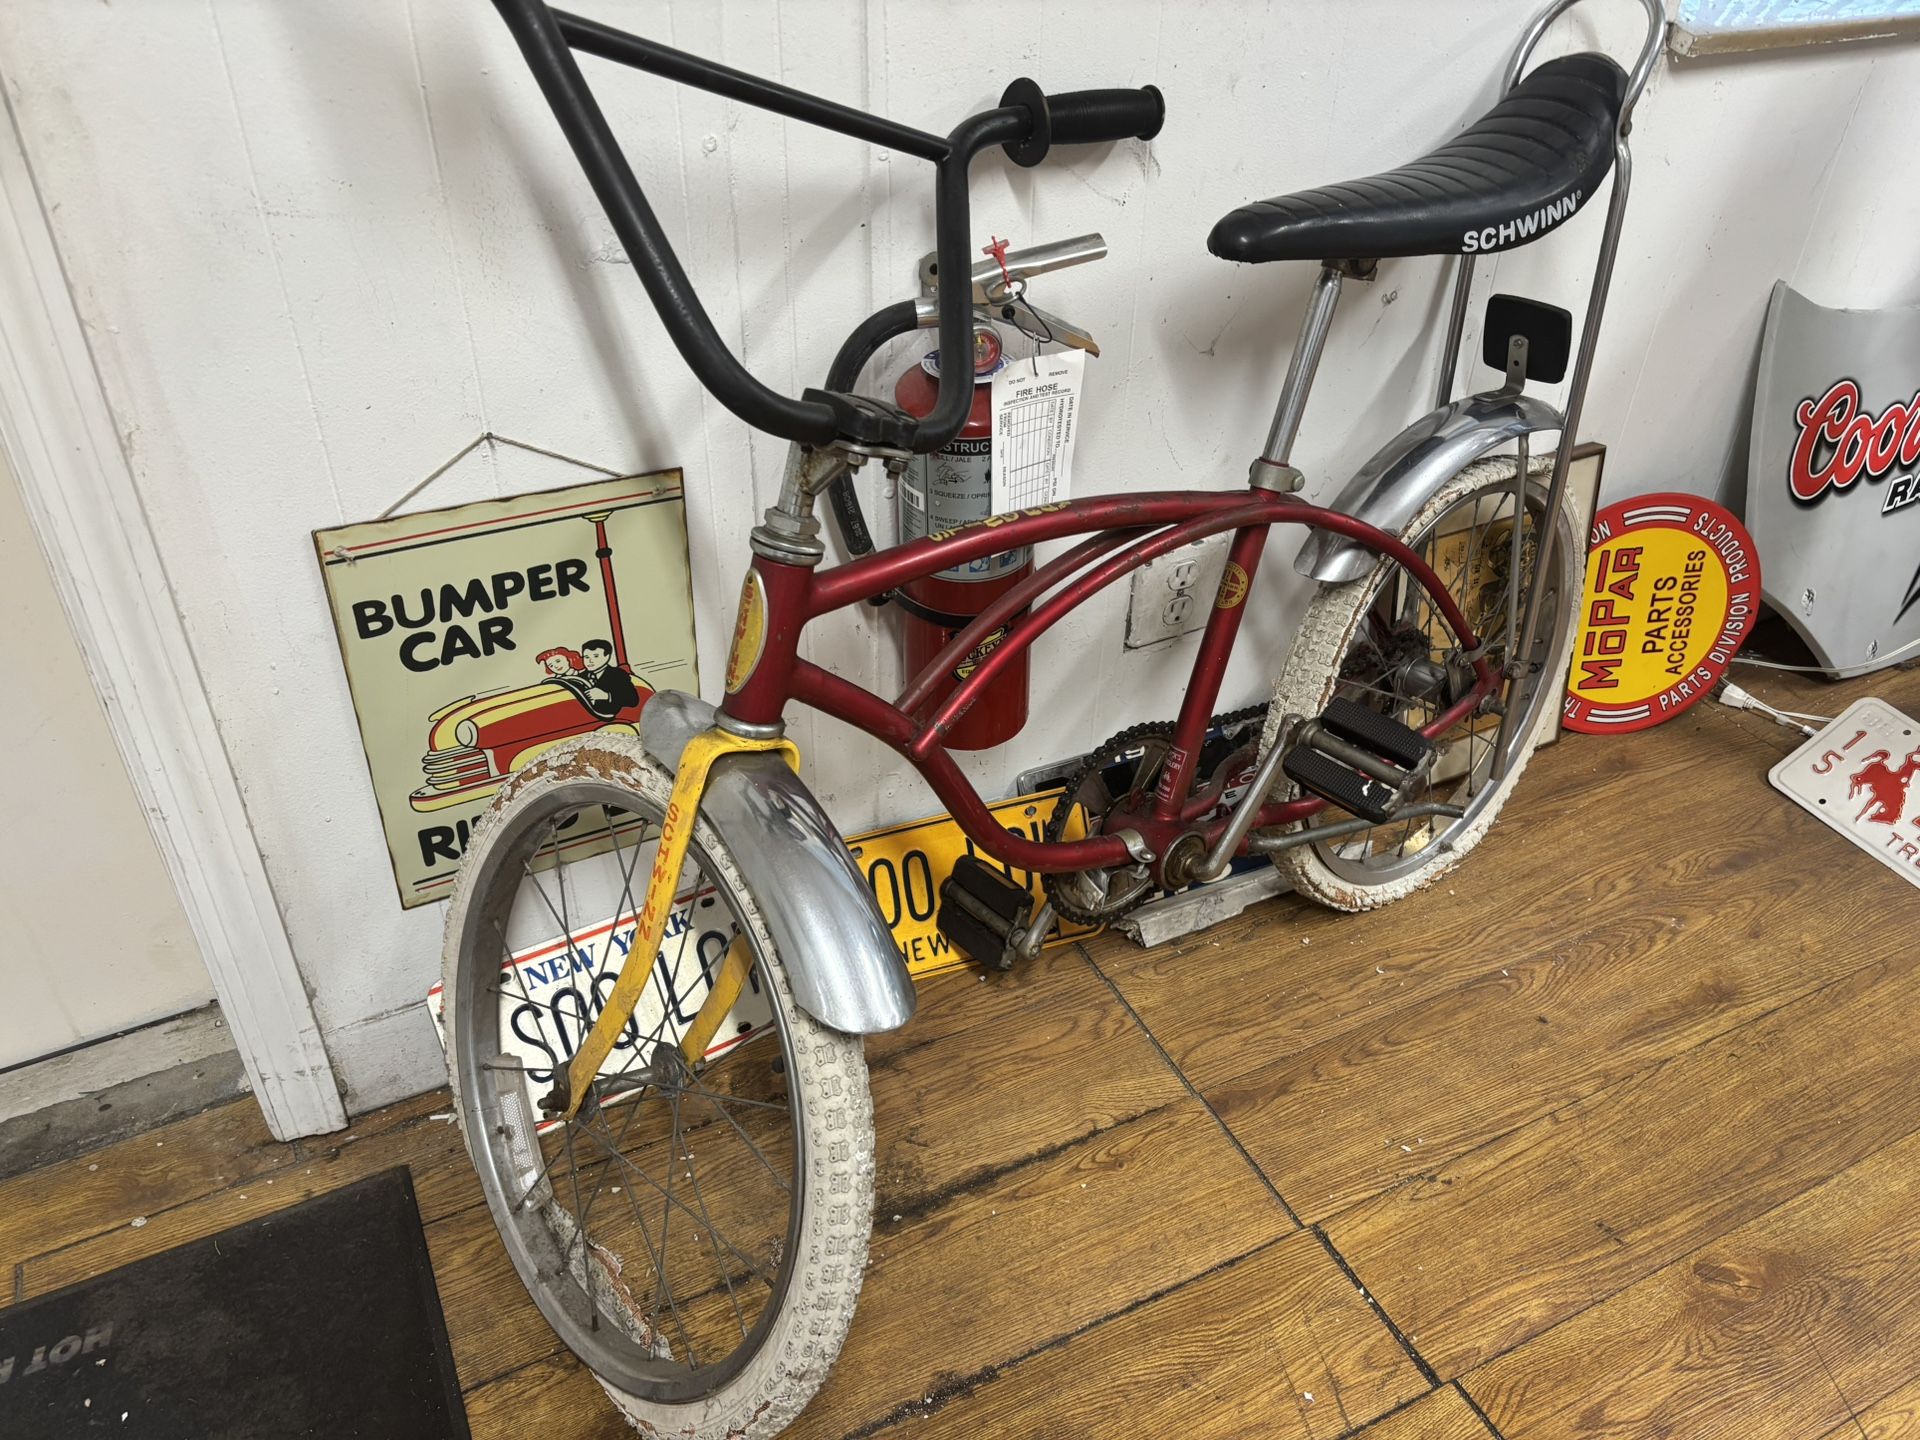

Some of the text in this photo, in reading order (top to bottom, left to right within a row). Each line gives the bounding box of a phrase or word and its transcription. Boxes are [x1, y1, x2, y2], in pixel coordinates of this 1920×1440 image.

[1003, 396, 1029, 407] INSPECTION
[1039, 391, 1051, 399] TEST
[1051, 388, 1071, 396] RECORD
[1015, 383, 1059, 399] FIRE HOSE
[1048, 369, 1069, 377] REMOVE
[1064, 419, 1072, 444] SERVICE
[934, 489, 966, 500] SQUEEZE
[352, 557, 592, 640] BUMPER
[1577, 546, 1644, 690] MOPAR
[1641, 575, 1678, 654] PARTS
[1658, 511, 1750, 711] PARTS DIVISION PRODUCTS
[1664, 550, 1707, 676] ACCESSORIES
[398, 615, 517, 673] CAR
[638, 802, 681, 941] SCHWINN
[522, 943, 596, 990] NEW
[22, 1320, 115, 1377] HOT
